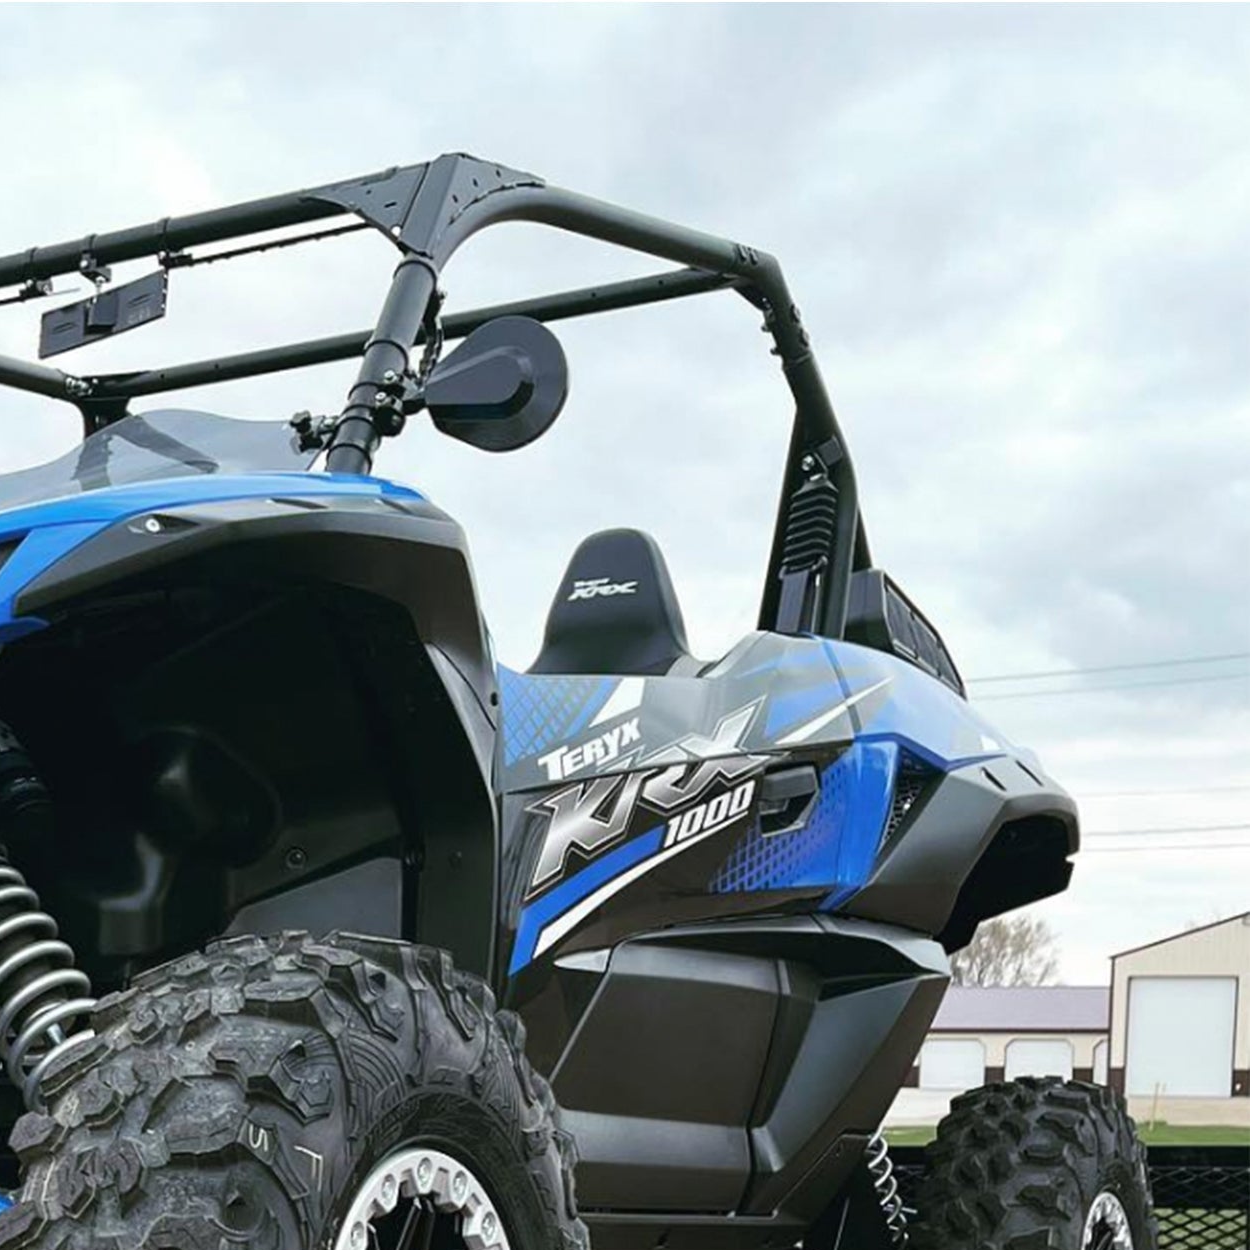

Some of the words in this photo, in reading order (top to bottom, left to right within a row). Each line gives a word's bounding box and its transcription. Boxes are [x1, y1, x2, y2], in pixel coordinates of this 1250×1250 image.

[537, 717, 641, 780] TERYX
[526, 696, 786, 899] KRX
[664, 779, 756, 849] 1000
